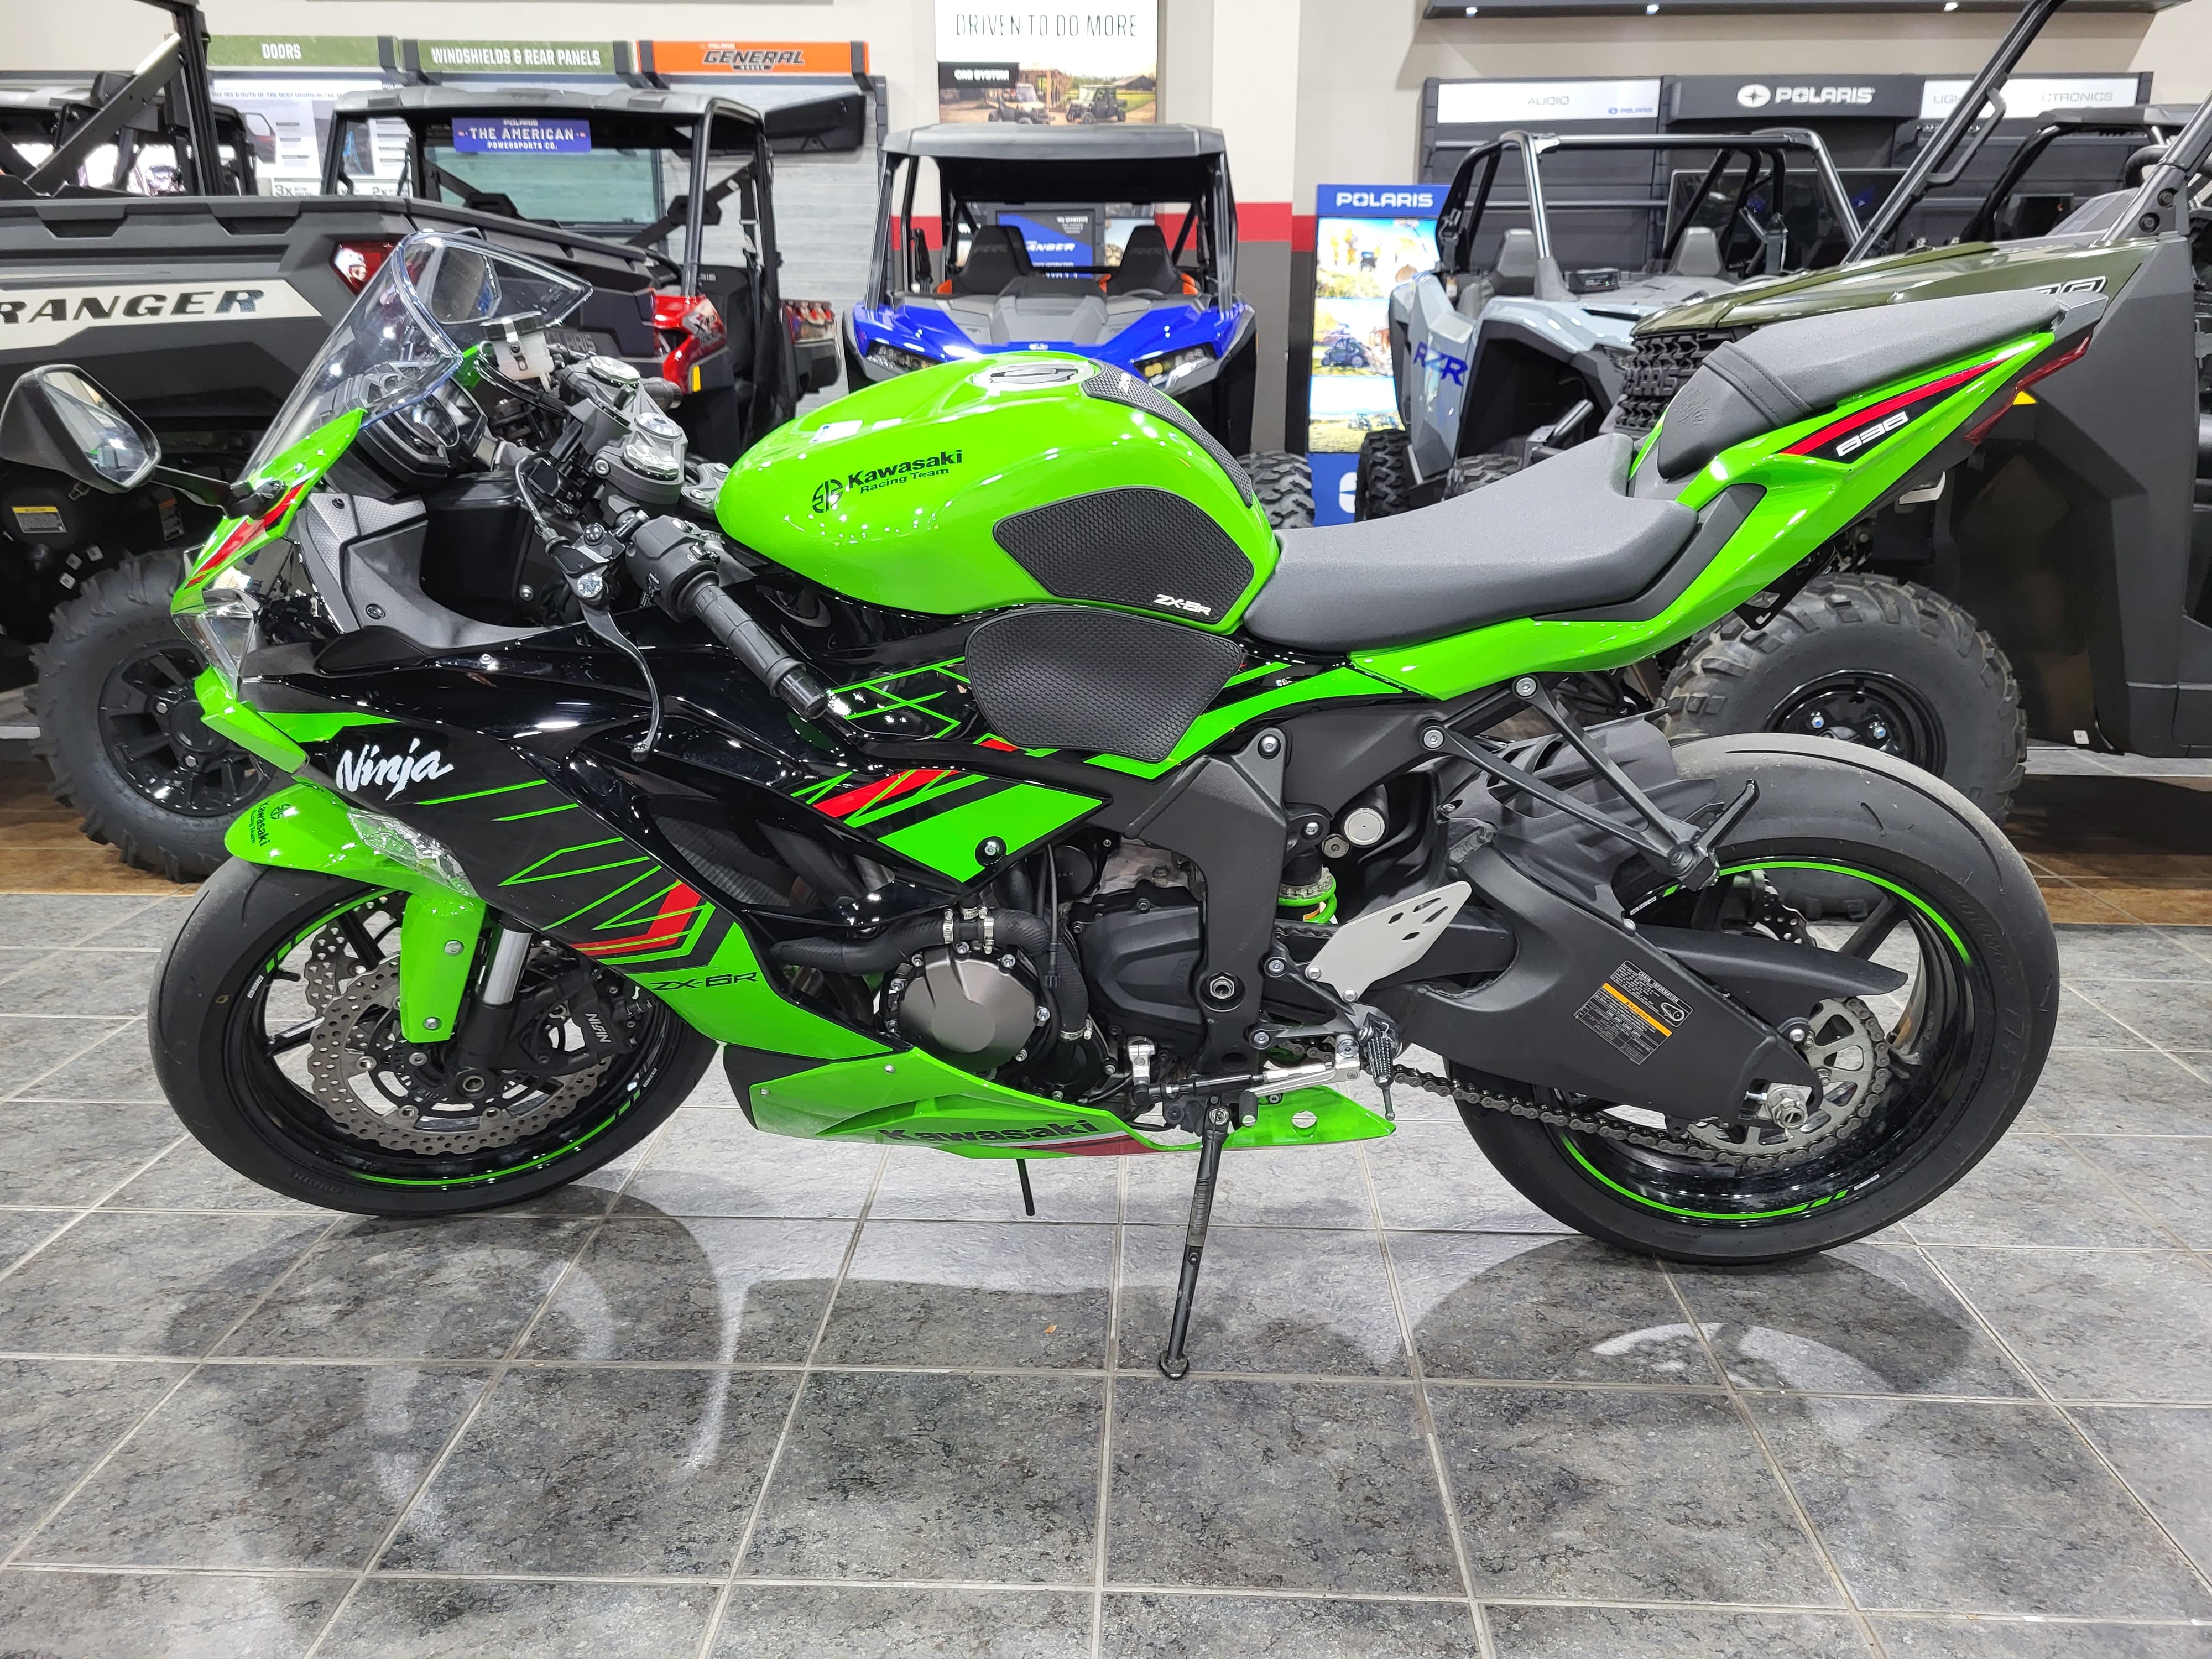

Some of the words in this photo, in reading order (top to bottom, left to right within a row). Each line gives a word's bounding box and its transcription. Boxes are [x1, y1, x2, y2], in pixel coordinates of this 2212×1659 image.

[956, 14, 1020, 36] DRIVEN
[1027, 15, 1048, 36] TO
[1057, 15, 1078, 36] DO
[1087, 15, 1138, 36] MORE
[261, 43, 301, 59] DOORS
[430, 48, 511, 64] WINDSHIELDS
[514, 49, 522, 64] &
[525, 49, 556, 66] REAR
[556, 49, 601, 66] PANELS
[703, 50, 805, 64] GENERAL
[1528, 96, 1570, 105] AUDIO
[1775, 87, 1874, 105] POLARIS
[469, 127, 496, 140] THE
[502, 128, 575, 141] AMERICAN
[487, 140, 543, 150] POWERSPORTS
[1335, 191, 1434, 208] POLARIS
[1025, 242, 1076, 252] ANGER
[0, 289, 265, 324] RANGER
[1413, 340, 1468, 387] RZR
[1835, 411, 1908, 457] 636
[848, 449, 963, 489] Kawasaki
[860, 476, 907, 494] Racing
[910, 468, 950, 480] Team
[335, 737, 455, 801] Ninja
[257, 801, 271, 847] Kawasaki
[649, 971, 759, 991] ZX-6R
[1637, 971, 1652, 983] CHAIN
[1652, 980, 1679, 1003] INFORMATION
[1629, 1003, 1649, 1020] WARNING
[1614, 1015, 1623, 1024] AND
[1621, 1021, 1632, 1032] LOAD
[1631, 1029, 1642, 1038] DATA
[877, 1119, 1100, 1141] Kawasaki
